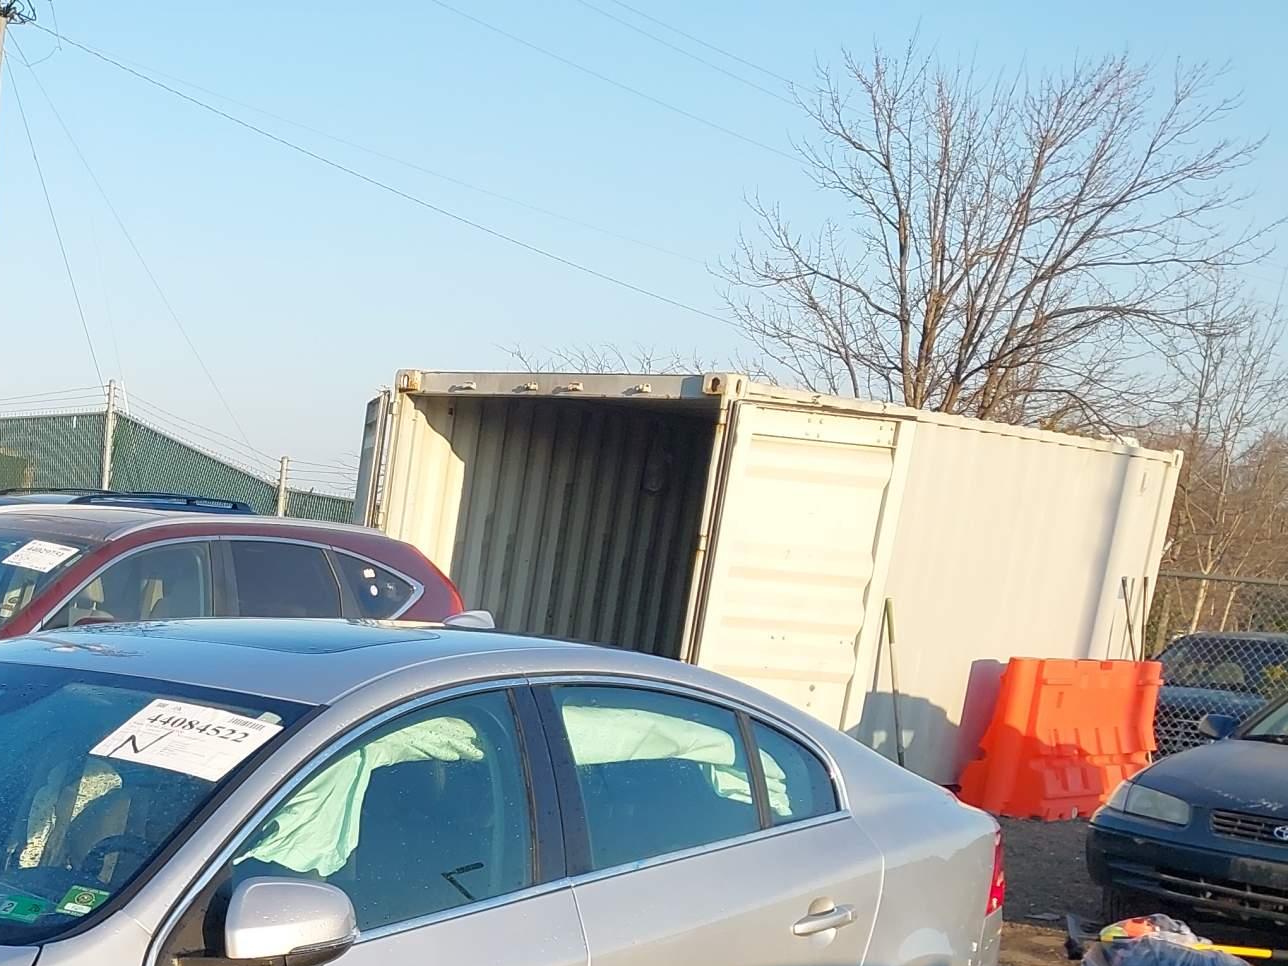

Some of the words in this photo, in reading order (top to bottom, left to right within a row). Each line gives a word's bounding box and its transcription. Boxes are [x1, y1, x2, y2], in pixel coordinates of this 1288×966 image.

[147, 713, 250, 743] 44084522
[106, 730, 175, 757] N
[2, 902, 15, 913] 2
